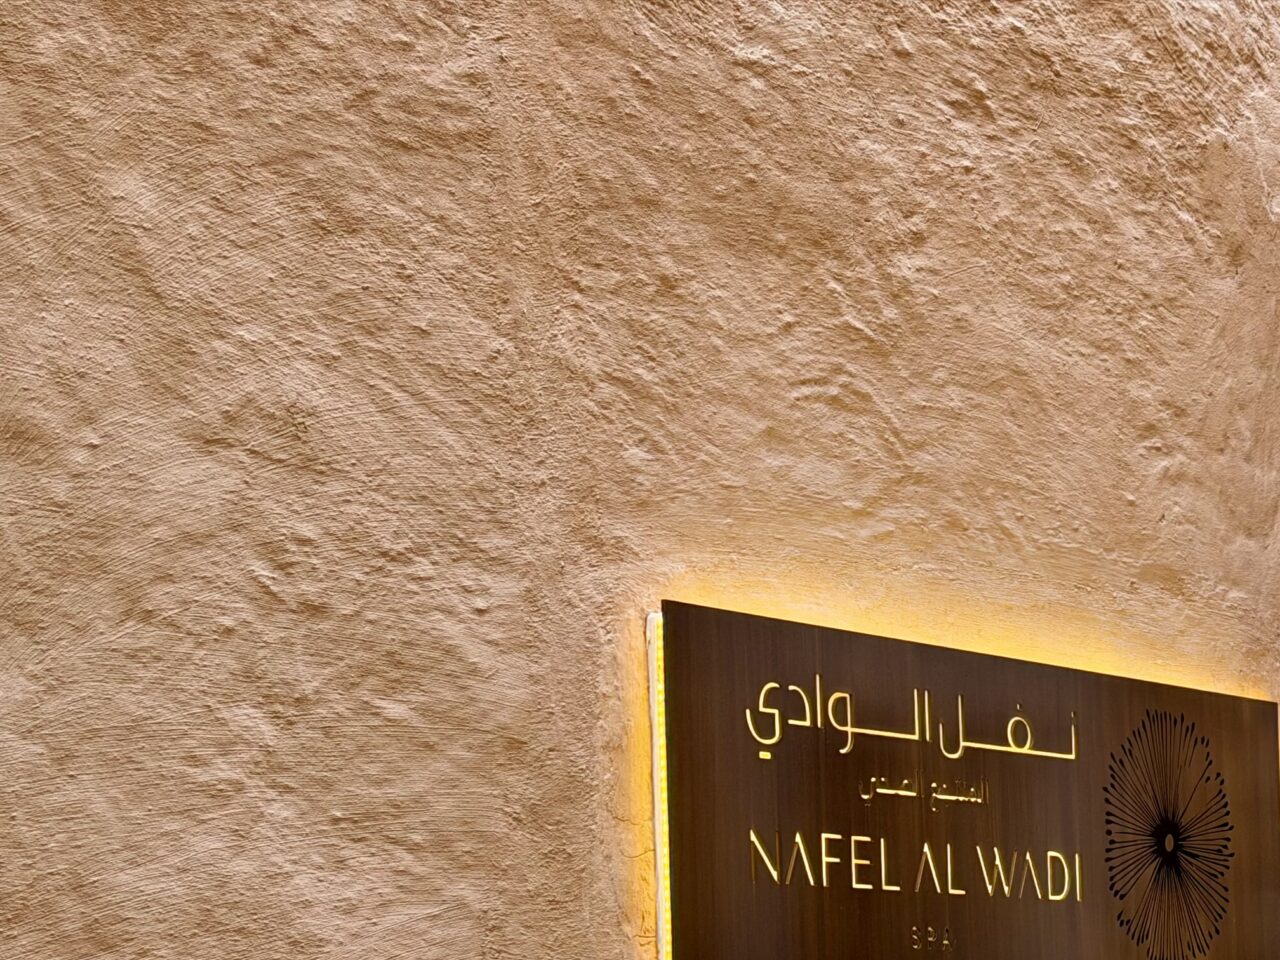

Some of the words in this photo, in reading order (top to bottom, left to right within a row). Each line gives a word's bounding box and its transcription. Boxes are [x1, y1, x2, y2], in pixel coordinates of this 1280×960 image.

[745, 673, 931, 760] الوادي
[939, 693, 1076, 760] نفل
[749, 828, 902, 892] NAFEL
[914, 841, 967, 896] AL
[975, 844, 1083, 902] WADI
[911, 925, 954, 951] SPA
